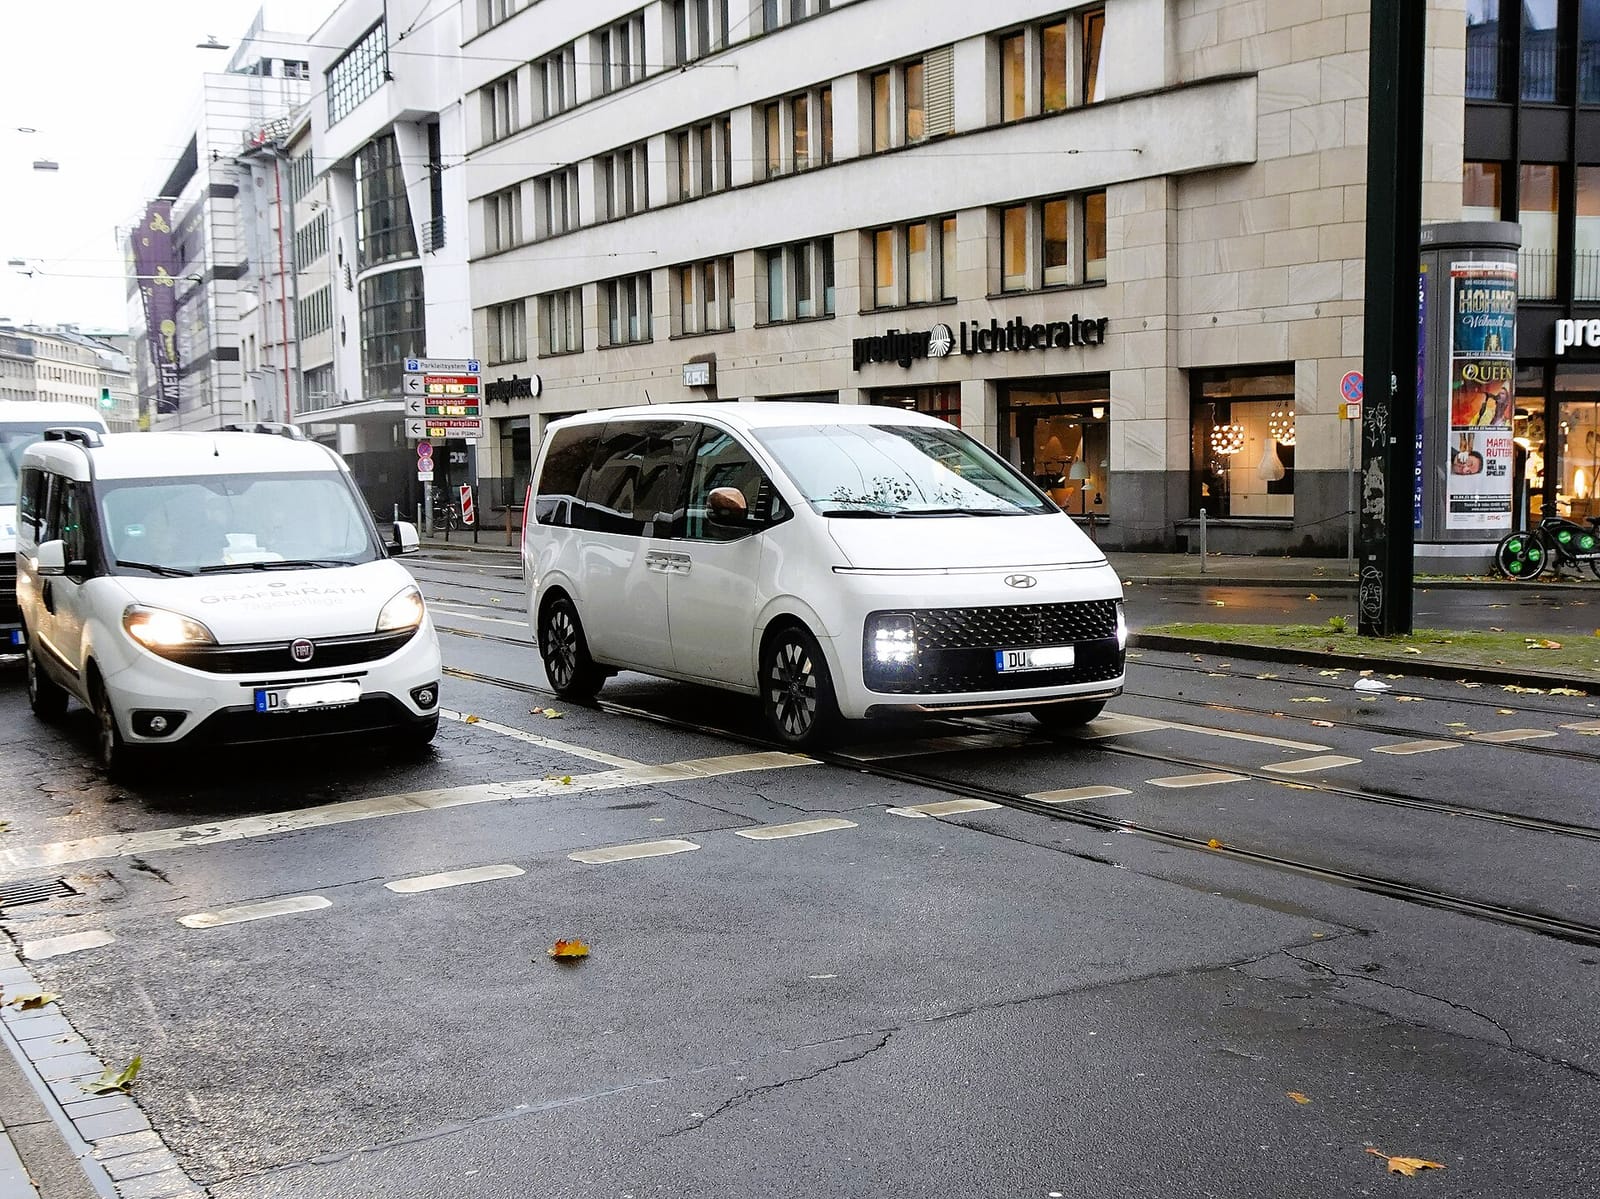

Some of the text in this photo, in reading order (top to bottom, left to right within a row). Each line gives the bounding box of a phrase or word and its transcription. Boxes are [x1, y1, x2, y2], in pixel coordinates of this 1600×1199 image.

[1554, 318, 1600, 355] pre
[420, 362, 467, 370] Parkleitsystem
[425, 376, 458, 384] Stadtmitte
[1462, 363, 1513, 384] QUEEN
[427, 420, 479, 428] Weitere Parkplätze
[295, 645, 310, 657] FIAT
[1008, 651, 1026, 668] DU
[267, 692, 278, 709] D
